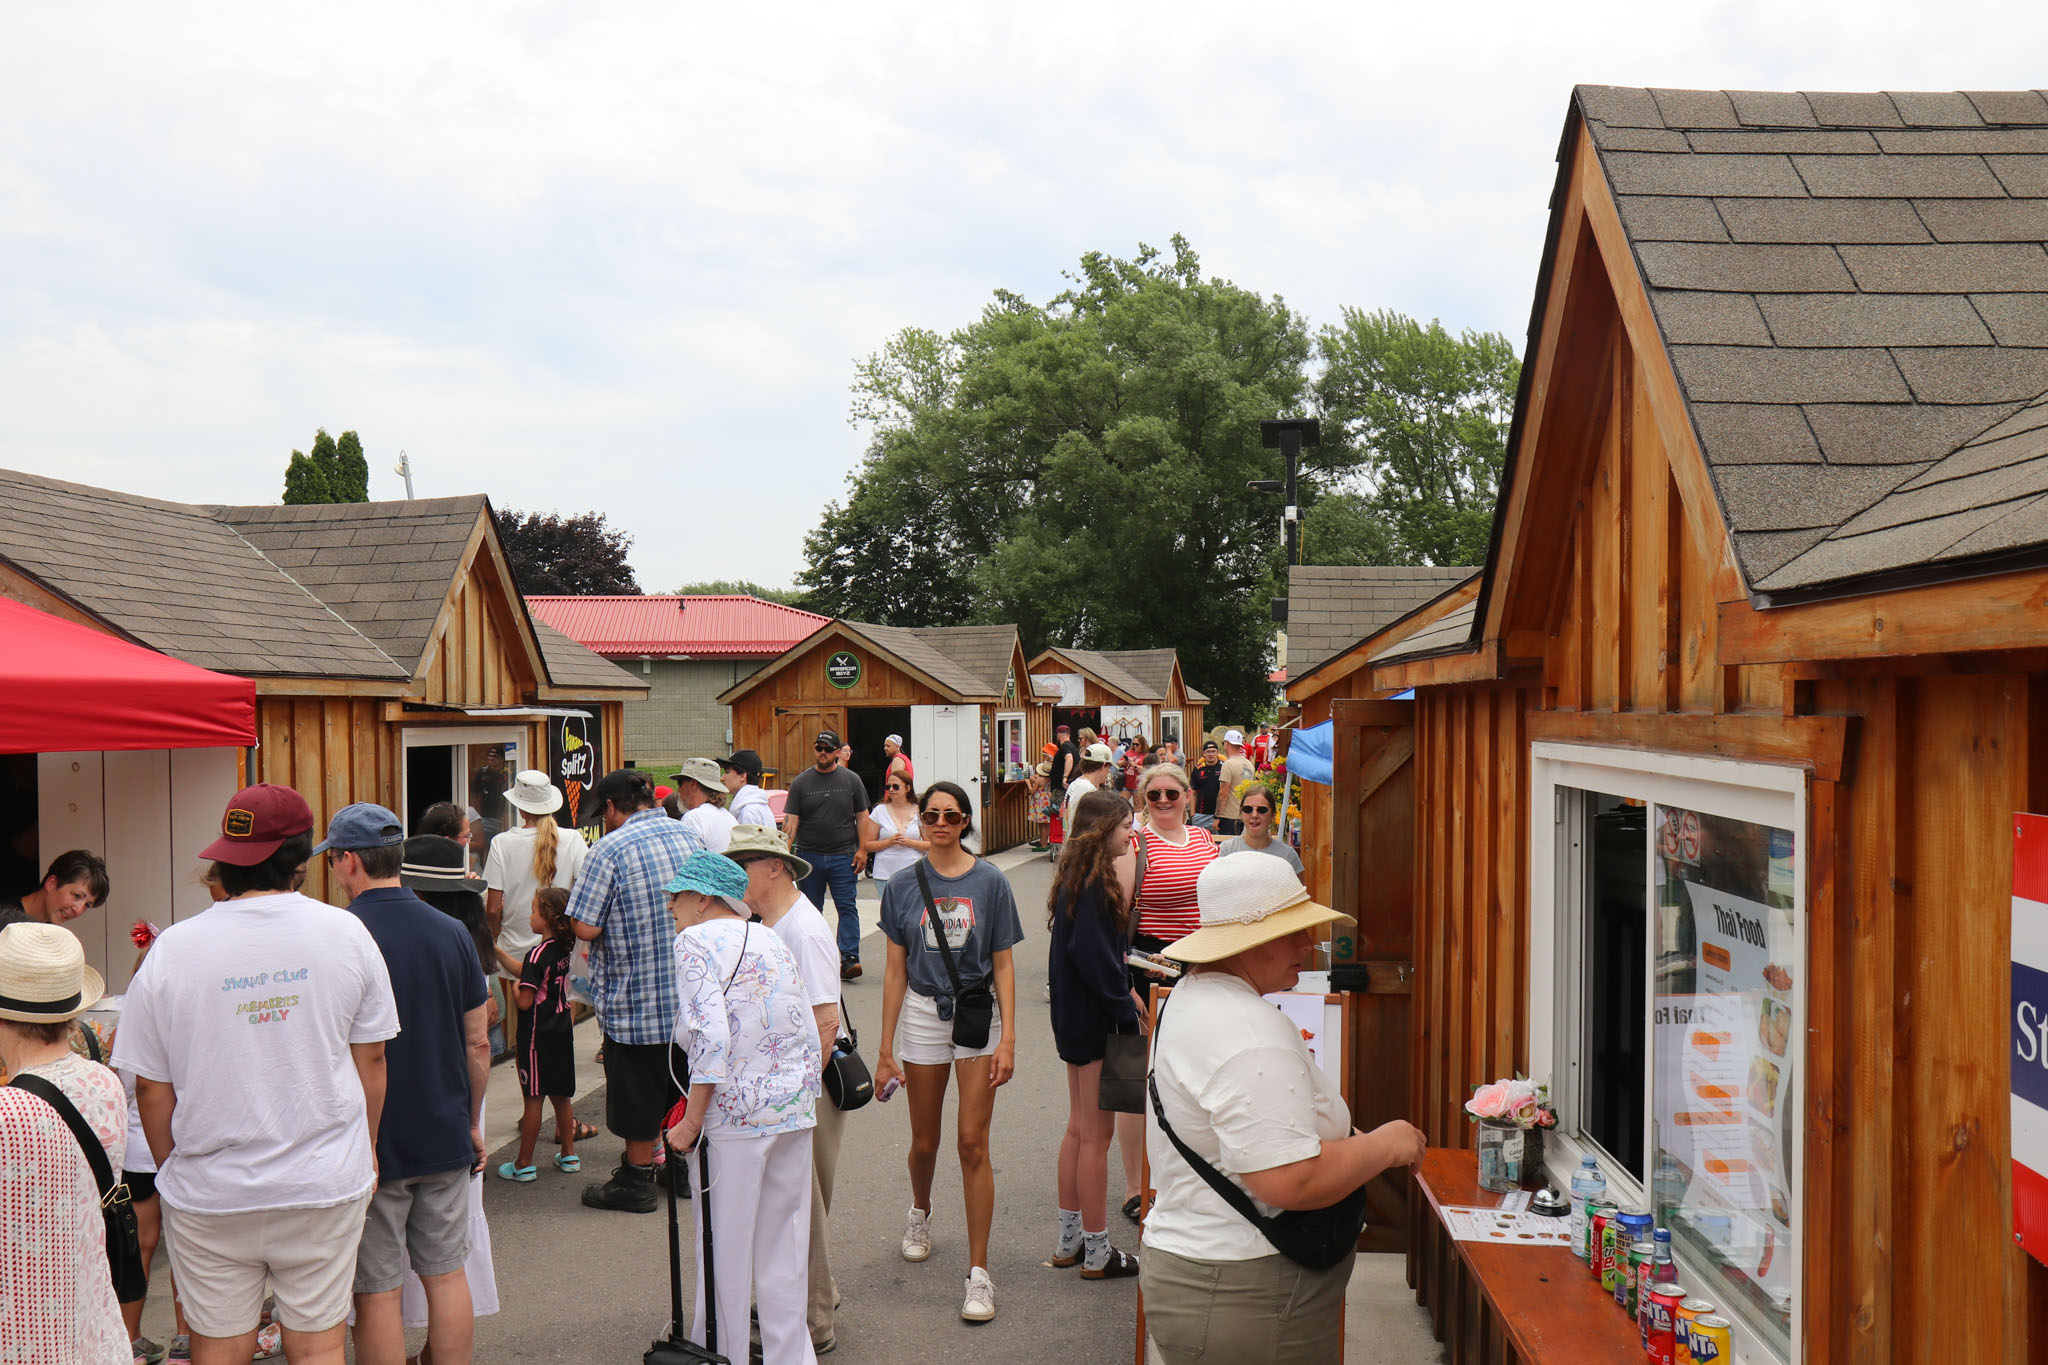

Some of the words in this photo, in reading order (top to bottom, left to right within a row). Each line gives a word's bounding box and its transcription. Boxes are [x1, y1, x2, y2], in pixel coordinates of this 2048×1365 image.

[928, 918, 968, 930] CADIAN
[1714, 904, 1737, 938] Thai
[1736, 912, 1766, 949] Food
[1335, 936, 1353, 959] 3
[222, 972, 269, 992] SWAMP
[273, 968, 308, 983] CLUB
[236, 995, 299, 1015] MEMBERS
[248, 1009, 290, 1024] ONLY
[1689, 1332, 1719, 1355] NTA
